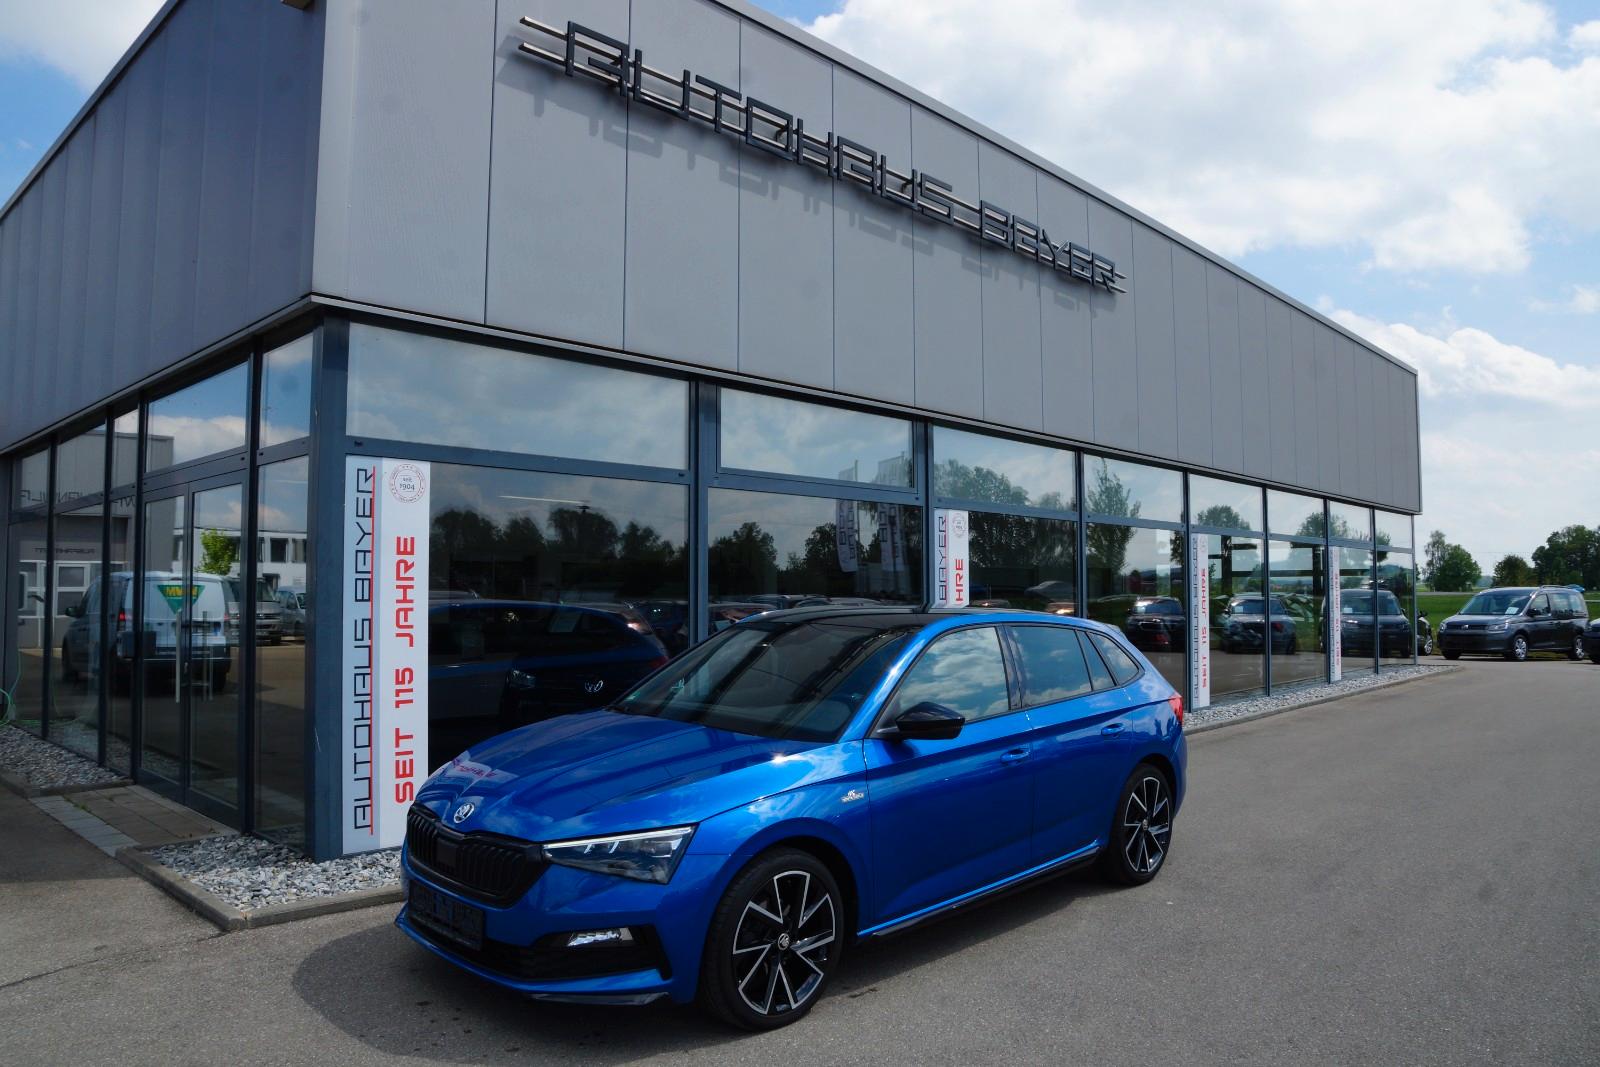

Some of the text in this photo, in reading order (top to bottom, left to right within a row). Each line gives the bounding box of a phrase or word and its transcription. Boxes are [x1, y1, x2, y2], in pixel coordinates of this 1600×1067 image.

[565, 21, 1116, 294] AUTOHAUS BAYER
[353, 468, 373, 829] AUTOHAUS BAYER
[394, 536, 415, 804] SEIT 115 JAHRE
[955, 558, 963, 601] HRE
